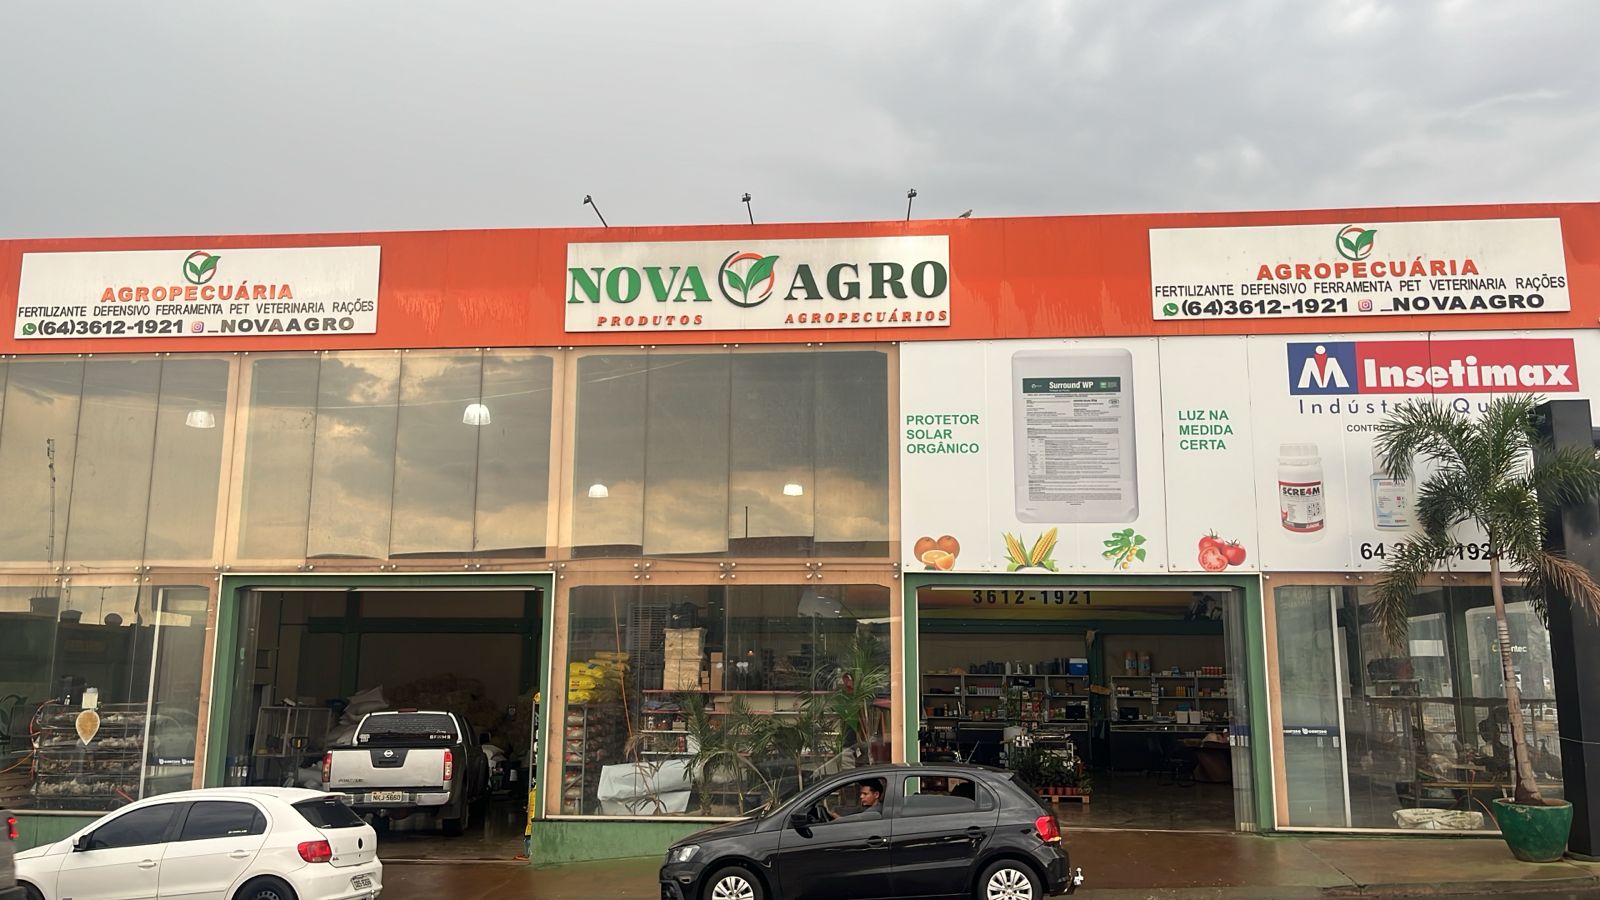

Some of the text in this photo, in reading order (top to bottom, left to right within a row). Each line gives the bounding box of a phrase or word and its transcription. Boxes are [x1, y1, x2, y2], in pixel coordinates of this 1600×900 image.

[1256, 256, 1479, 281] AGROPECUÁRIA
[568, 261, 948, 304] NOVA AGRO
[1155, 273, 1566, 297] FERTILIZANTE DEFENSIVO FERRAMENTA PET VETERINARIA RAÇÕES
[100, 280, 294, 303] AGROPECUÁRIA
[18, 297, 374, 318] FERTILIZANTE DEFENSIVO FERRAMENTA PET VETERINARIA RAÇÕES
[1181, 297, 1349, 317] (64)3612-1921
[597, 308, 948, 327] PRODUTOS AGROPECUÁRIOS
[38, 319, 184, 336] (64)3612-1921
[1363, 355, 1573, 388] Insetimax
[1049, 381, 1080, 390] Surround
[1082, 381, 1094, 389] WP
[906, 414, 980, 426] PROTETOR
[1178, 410, 1229, 421] LUZ NA
[906, 429, 953, 440] SOLAR
[1179, 425, 1233, 436] MEDIDA
[906, 441, 980, 454] ORGÂNICO
[1179, 439, 1227, 451] CERTA
[1360, 542, 1386, 560] 64
[973, 589, 1091, 605] 3612-1921
